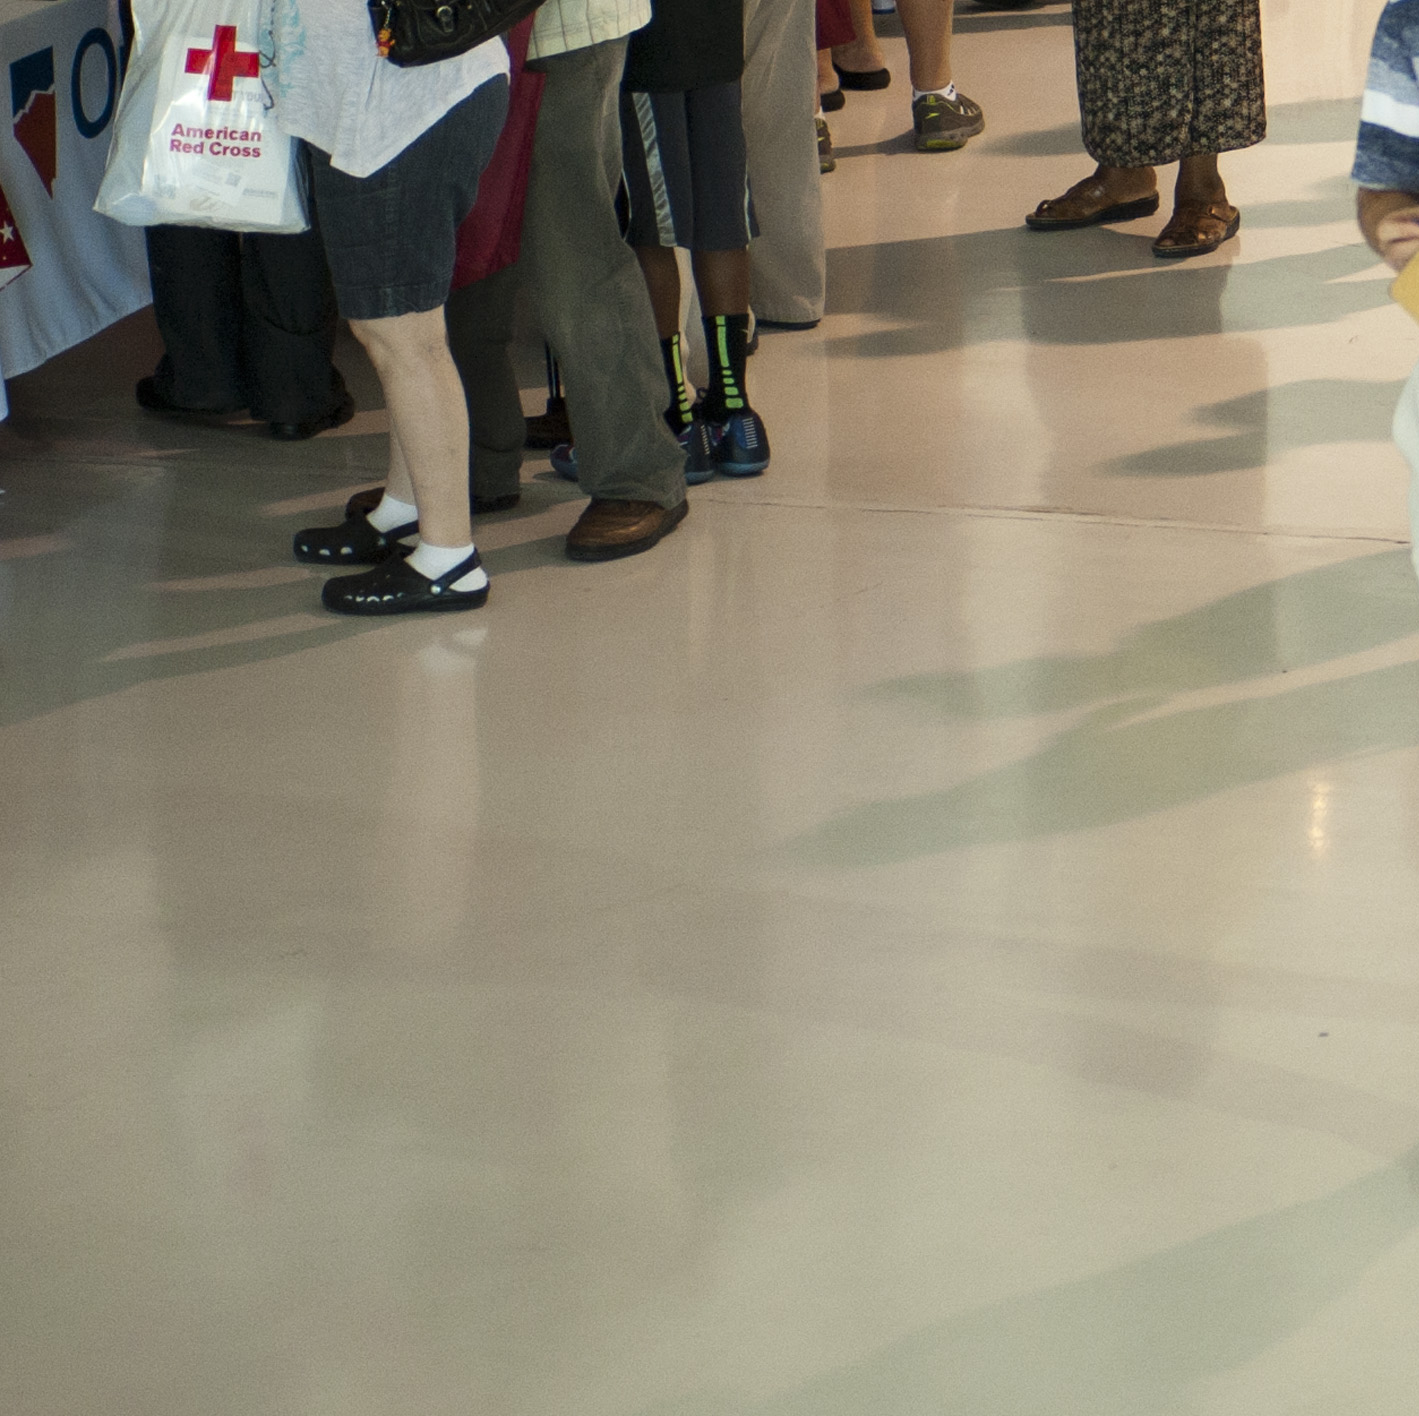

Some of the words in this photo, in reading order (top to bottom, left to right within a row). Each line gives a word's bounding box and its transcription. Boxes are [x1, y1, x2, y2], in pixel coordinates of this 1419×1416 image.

[171, 122, 262, 142] American
[169, 139, 205, 155] Red
[209, 141, 262, 158] Cross
